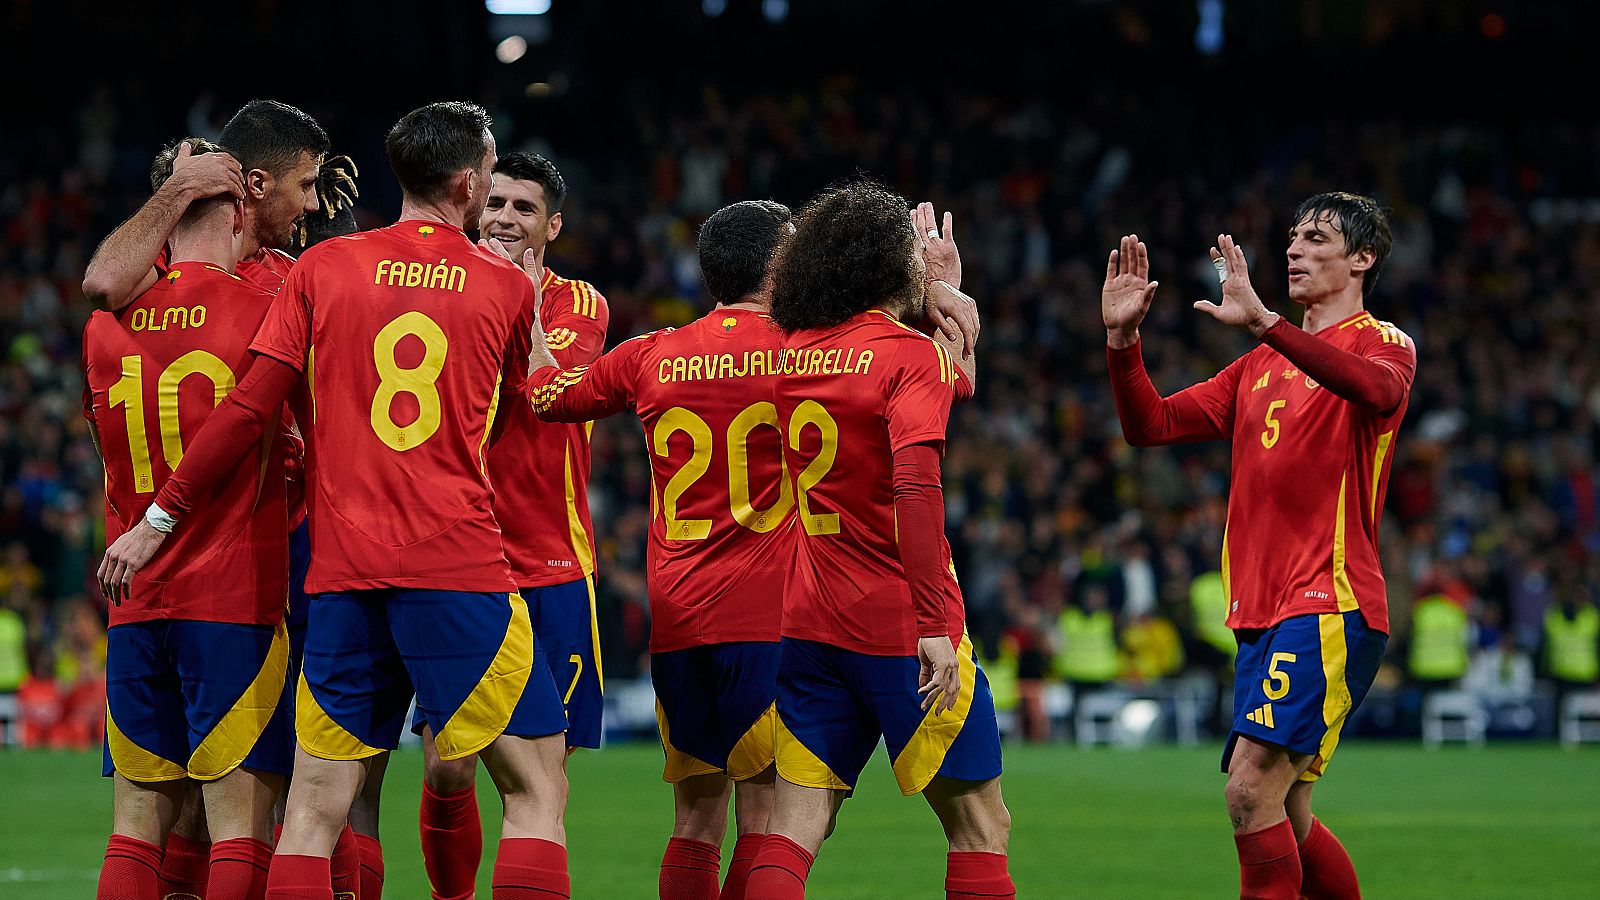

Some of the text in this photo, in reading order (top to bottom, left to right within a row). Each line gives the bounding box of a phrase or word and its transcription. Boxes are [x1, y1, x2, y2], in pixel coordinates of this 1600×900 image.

[375, 258, 467, 293] FABIÁN
[131, 305, 206, 332] OLMO
[370, 311, 448, 452] 8
[658, 350, 777, 384] CARVAJAL
[108, 349, 236, 493] 10
[1261, 399, 1287, 449] 5
[653, 401, 795, 540] 20
[788, 399, 841, 536] 2
[563, 654, 583, 705] 7
[1262, 651, 1297, 701] 5
